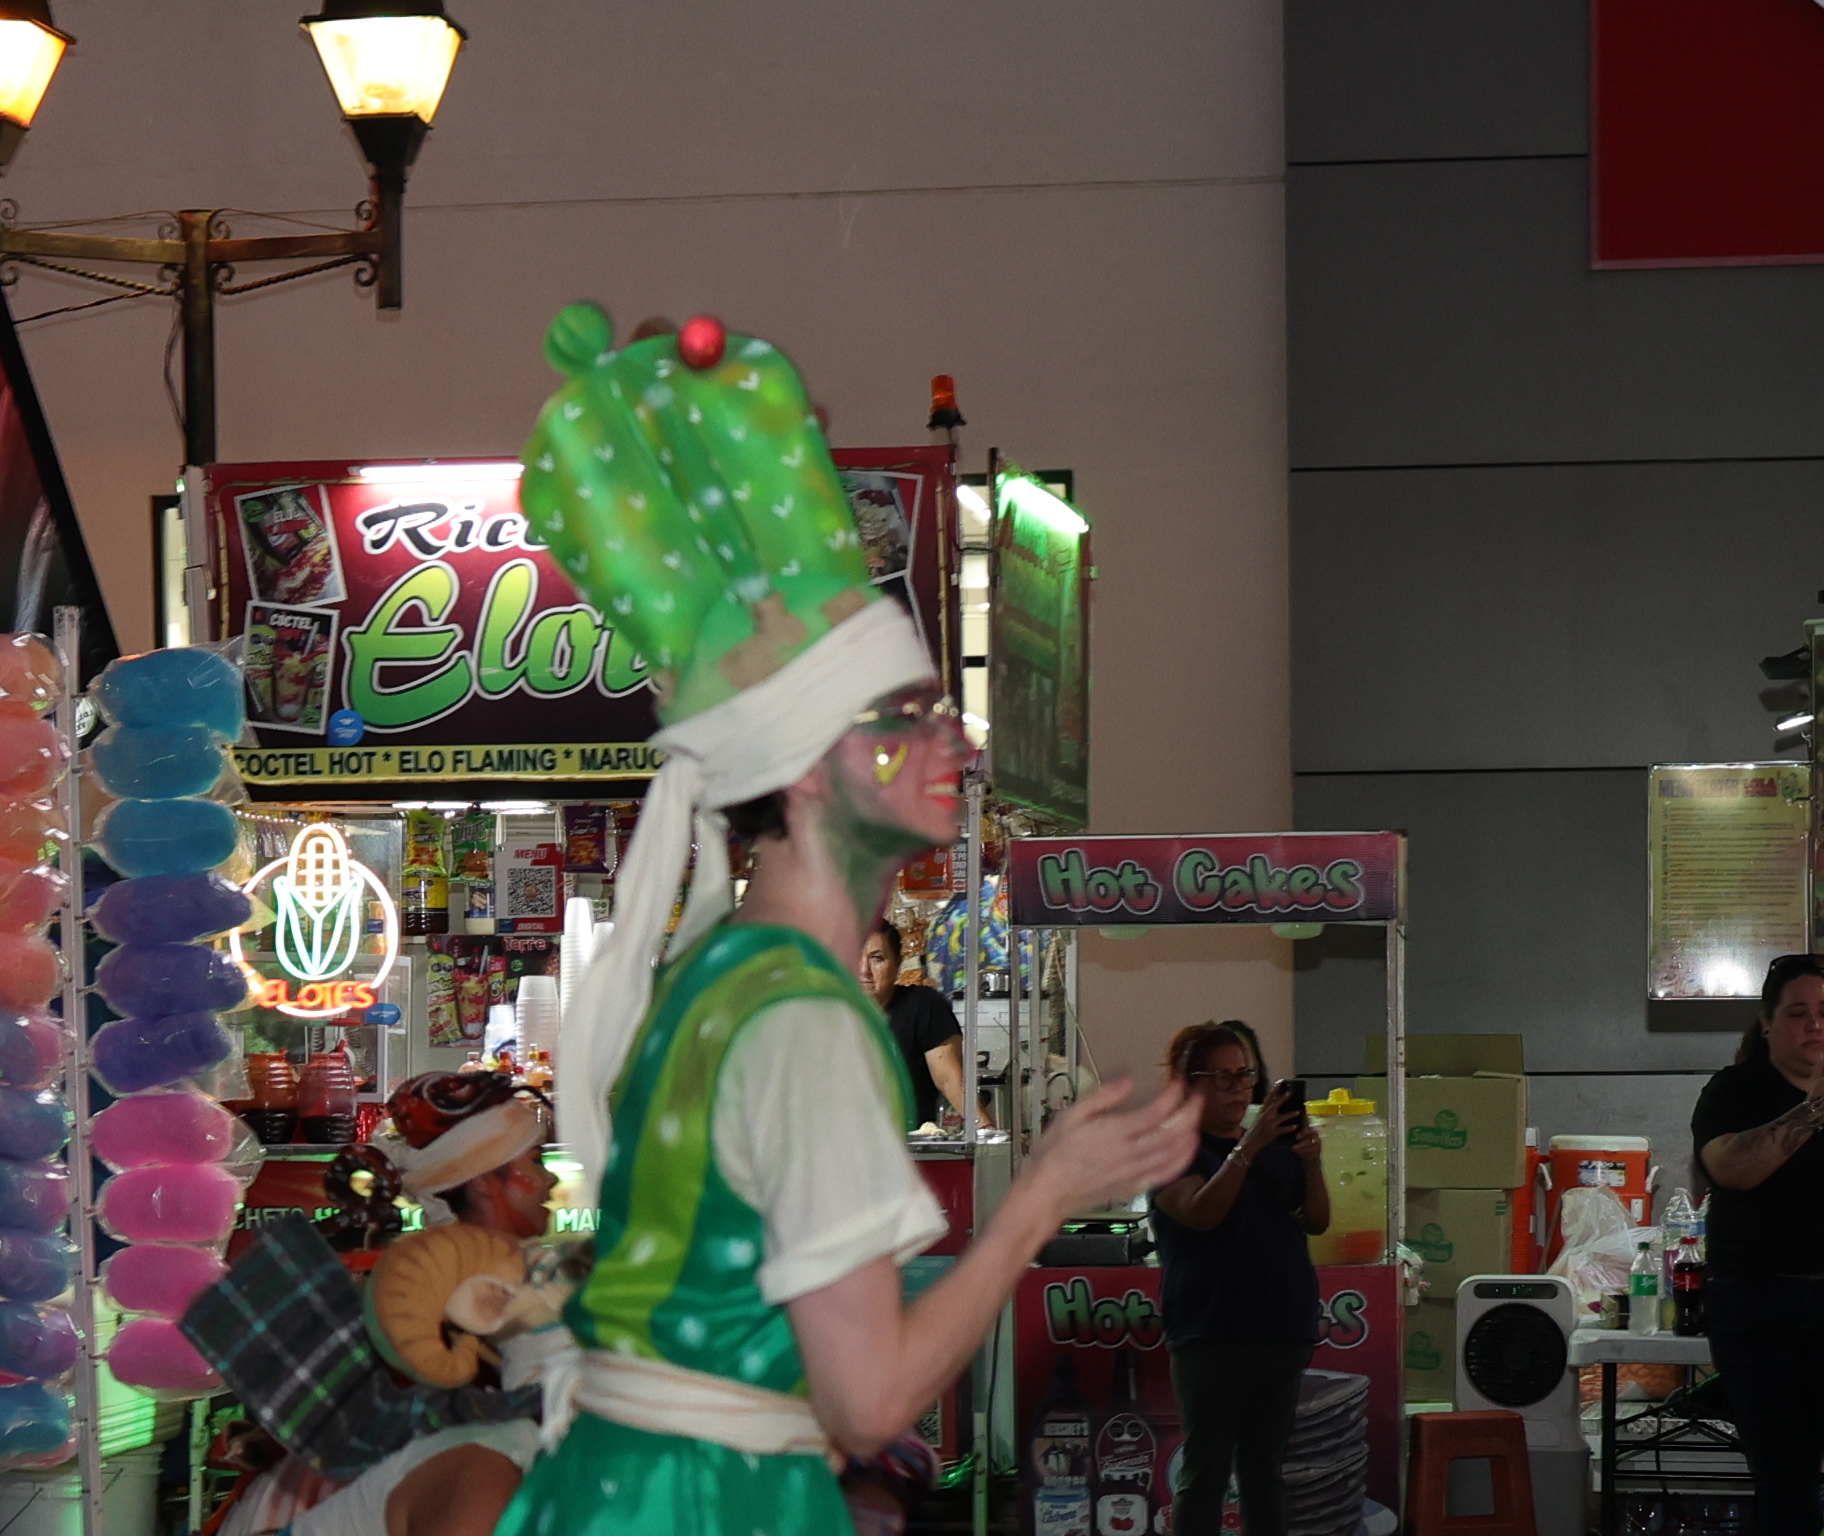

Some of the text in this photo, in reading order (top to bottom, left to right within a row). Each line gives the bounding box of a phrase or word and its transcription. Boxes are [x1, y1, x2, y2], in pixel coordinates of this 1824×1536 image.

[269, 613, 314, 630] COCTEL
[329, 750, 377, 775] HOT
[398, 751, 445, 773] ELO
[452, 748, 557, 773] FLAMING
[514, 848, 548, 860] MENU
[1038, 847, 1160, 915] Hot
[1176, 847, 1367, 913] Cakes
[502, 935, 548, 953] Torre
[1044, 1276, 1167, 1350] Hot
